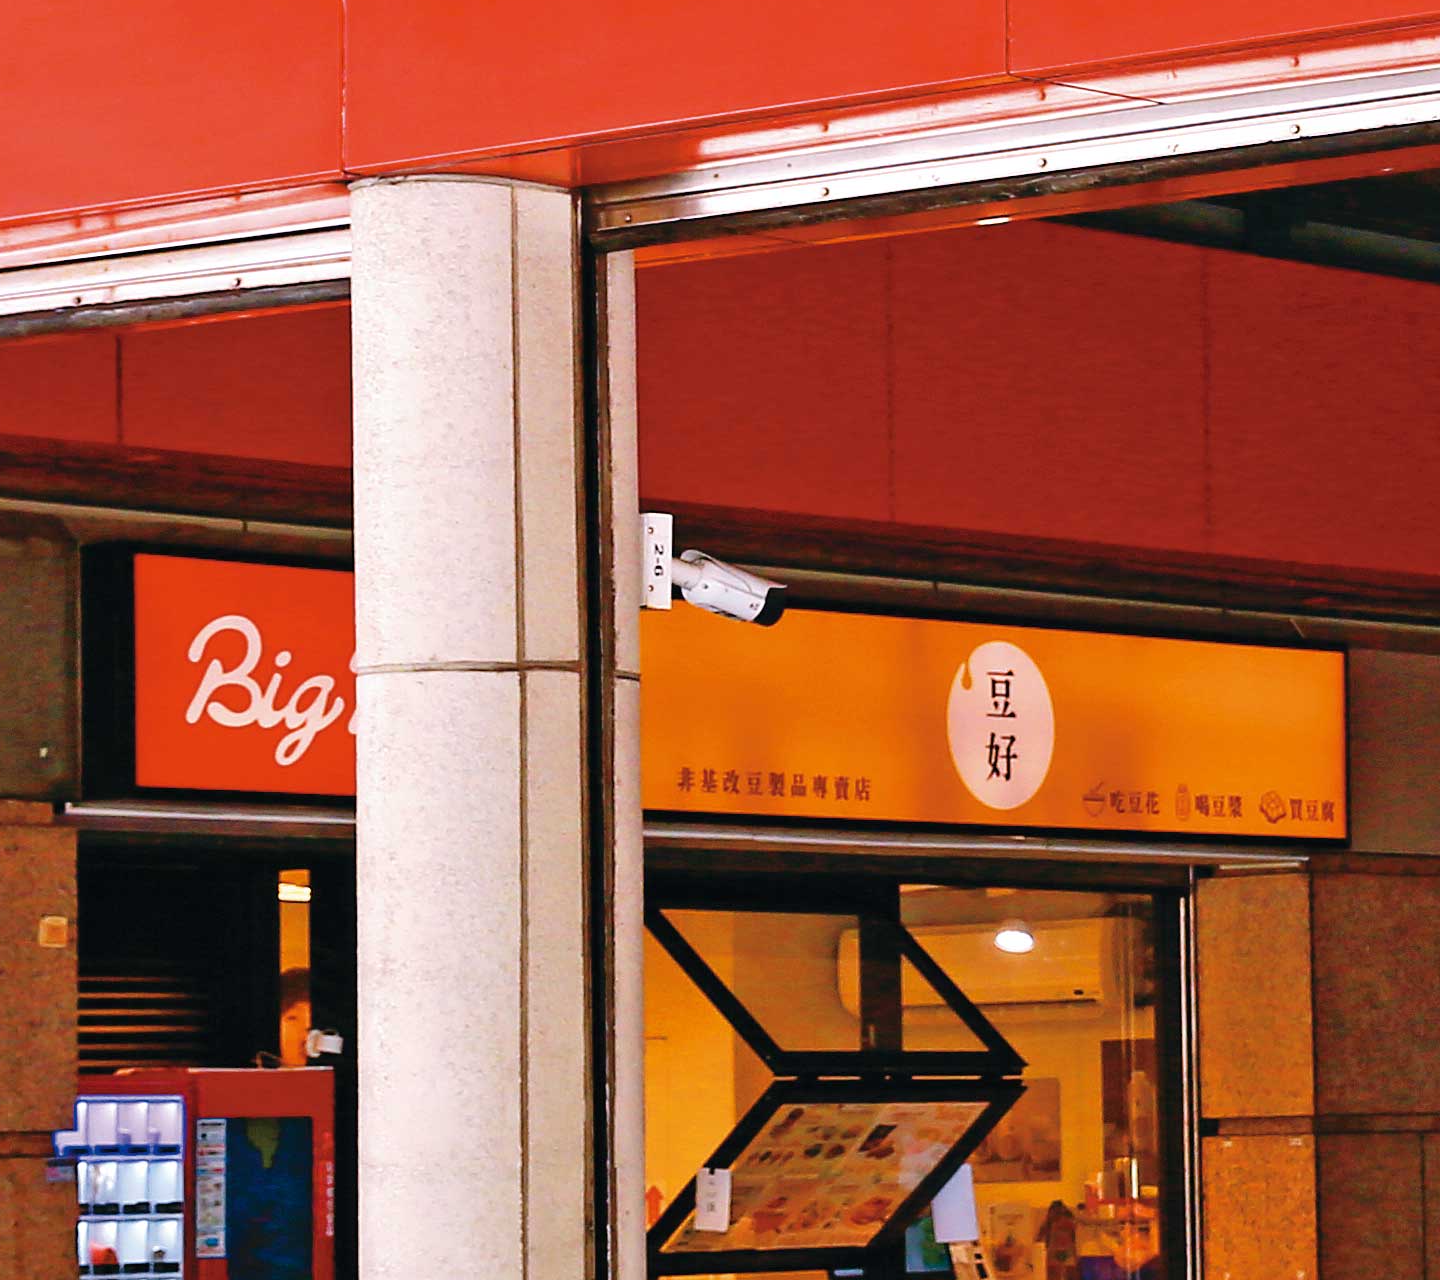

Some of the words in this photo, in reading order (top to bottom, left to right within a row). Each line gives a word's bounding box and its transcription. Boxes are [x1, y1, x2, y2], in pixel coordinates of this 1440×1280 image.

[984, 670, 1019, 782] 豆好
[676, 766, 871, 802] 非基改豆製品專賣店
[1110, 790, 1161, 816] 吃豆花
[1194, 794, 1243, 819] 喝豆漿
